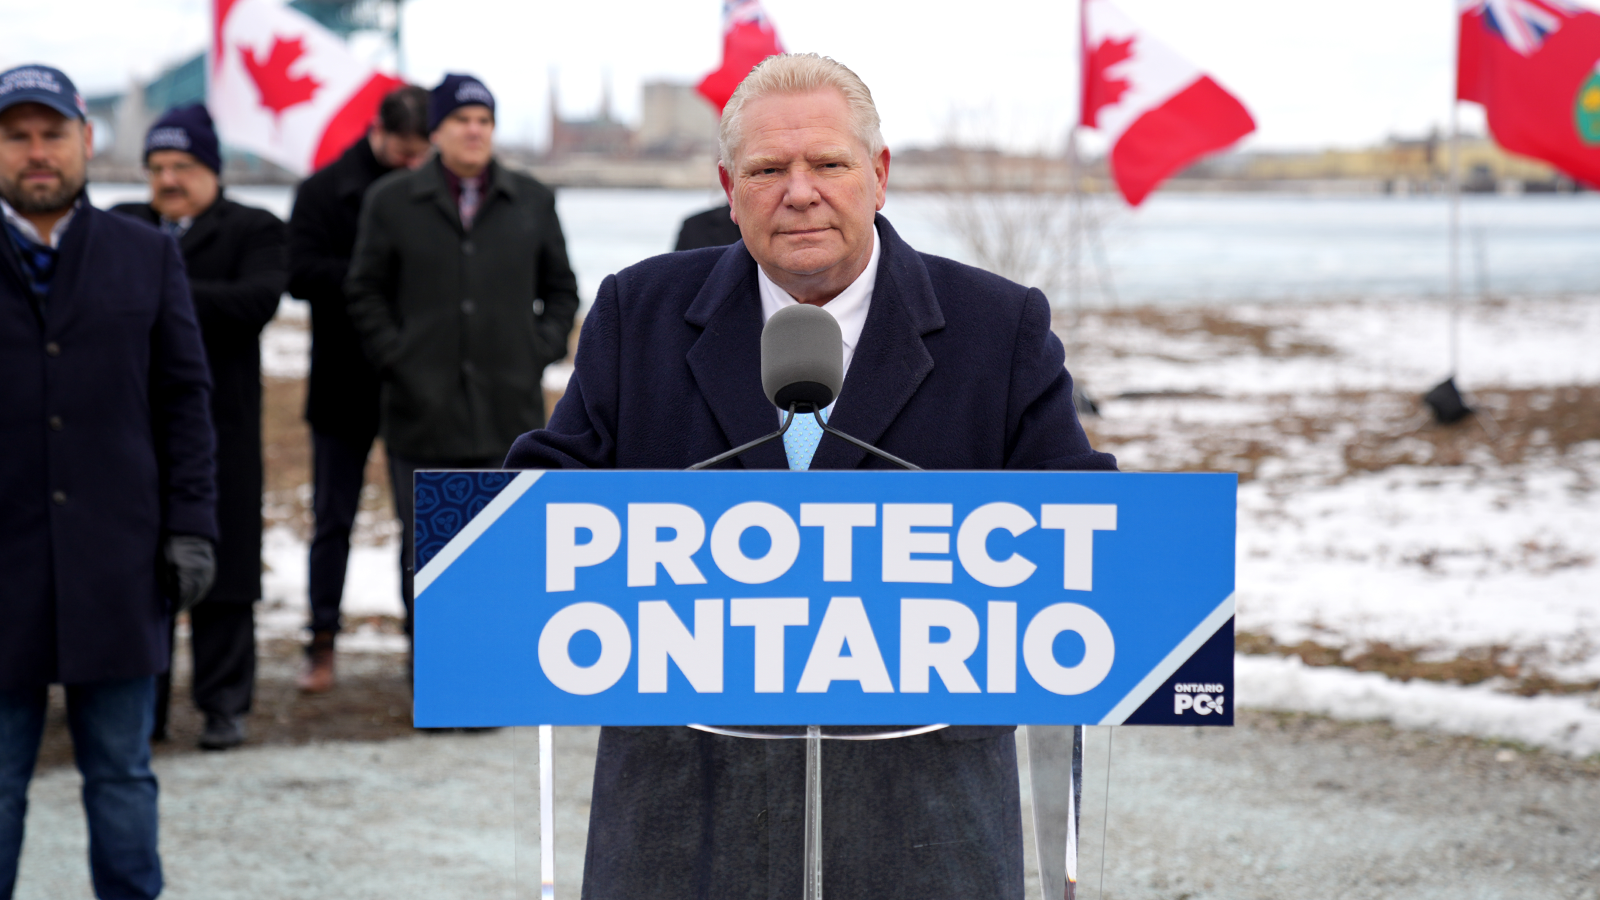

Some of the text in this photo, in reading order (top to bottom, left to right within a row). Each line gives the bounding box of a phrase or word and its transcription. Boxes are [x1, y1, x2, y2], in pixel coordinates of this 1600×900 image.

[545, 501, 1118, 592] PROTECT
[537, 597, 1116, 696] ONTARIO
[1174, 683, 1225, 693] ONTARIO
[1174, 693, 1214, 716] PC
